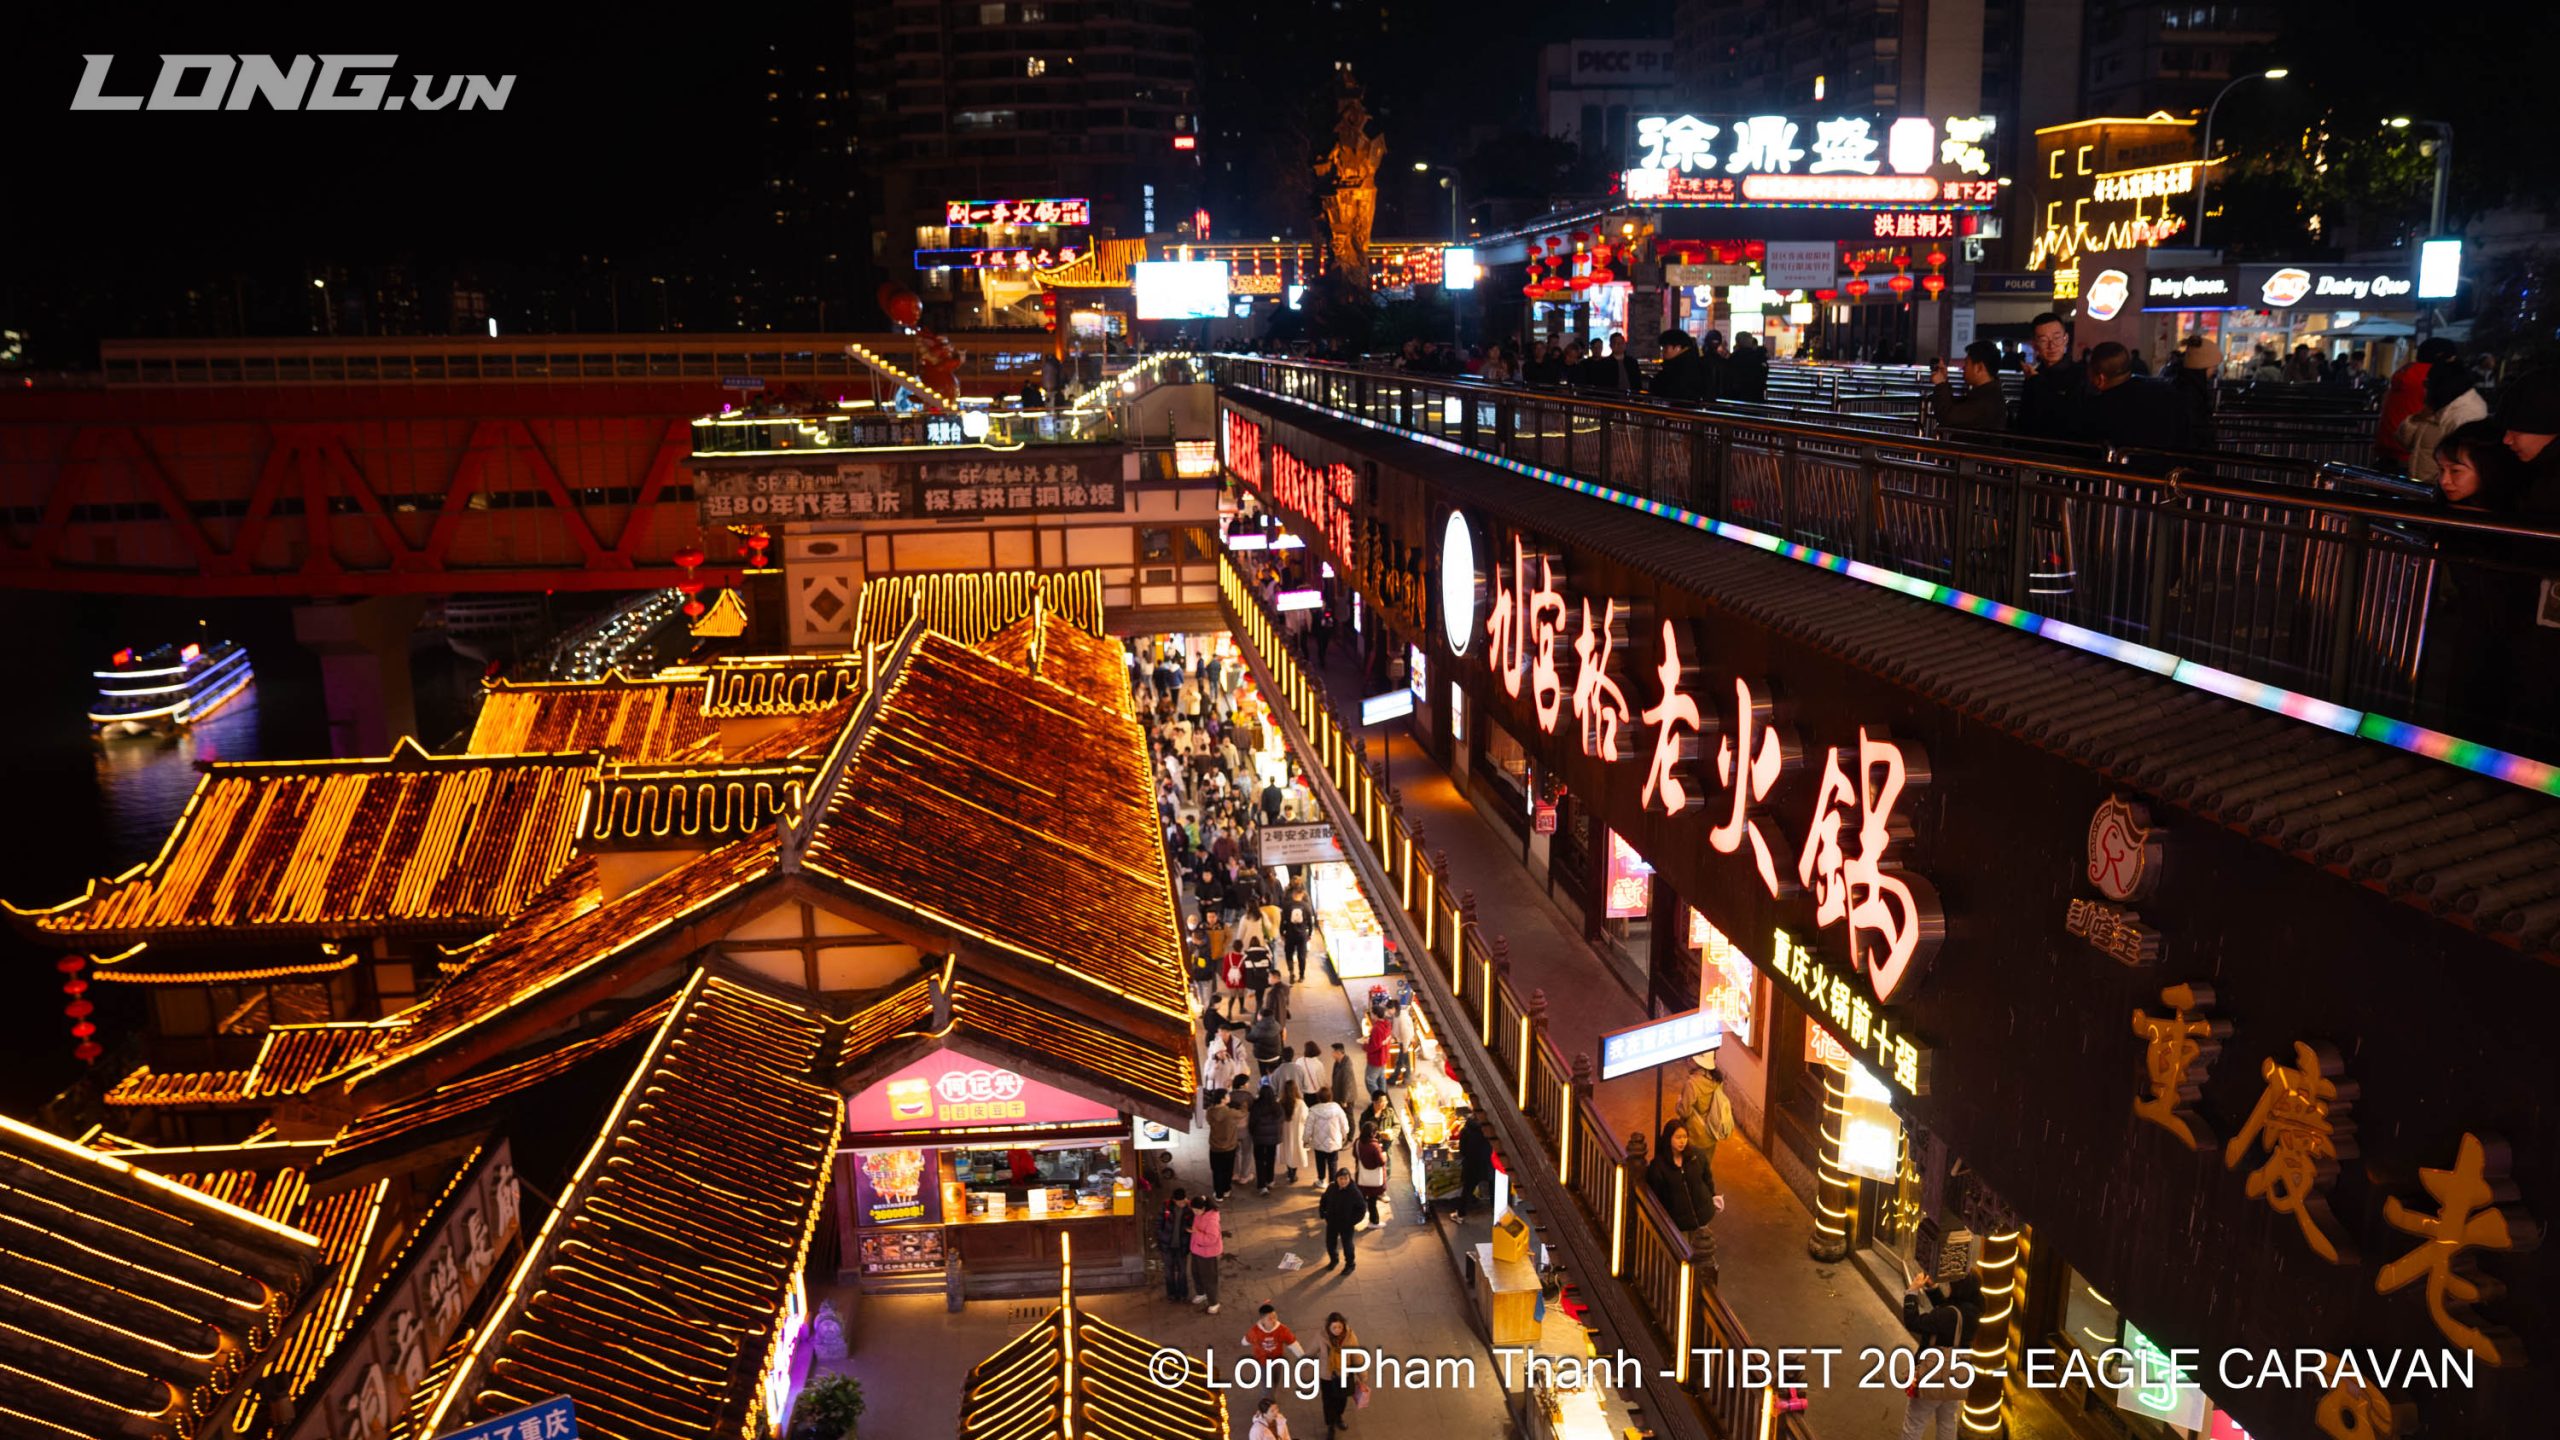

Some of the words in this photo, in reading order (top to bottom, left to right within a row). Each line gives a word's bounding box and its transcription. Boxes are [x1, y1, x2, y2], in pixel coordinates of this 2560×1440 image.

[1578, 50, 1630, 71] PICC
[1944, 181, 1998, 201] 请下2F
[2004, 279, 2036, 289] POLICE
[2149, 276, 2183, 299] Dairy
[2316, 276, 2370, 299] Dairy
[709, 490, 901, 517] 逛80年代老重庆
[924, 484, 1115, 511] 探索洪崖洞秘境
[1487, 534, 1920, 1003] 九宫格老火锅
[1773, 927, 1919, 1096] 重庆火锅前十强
